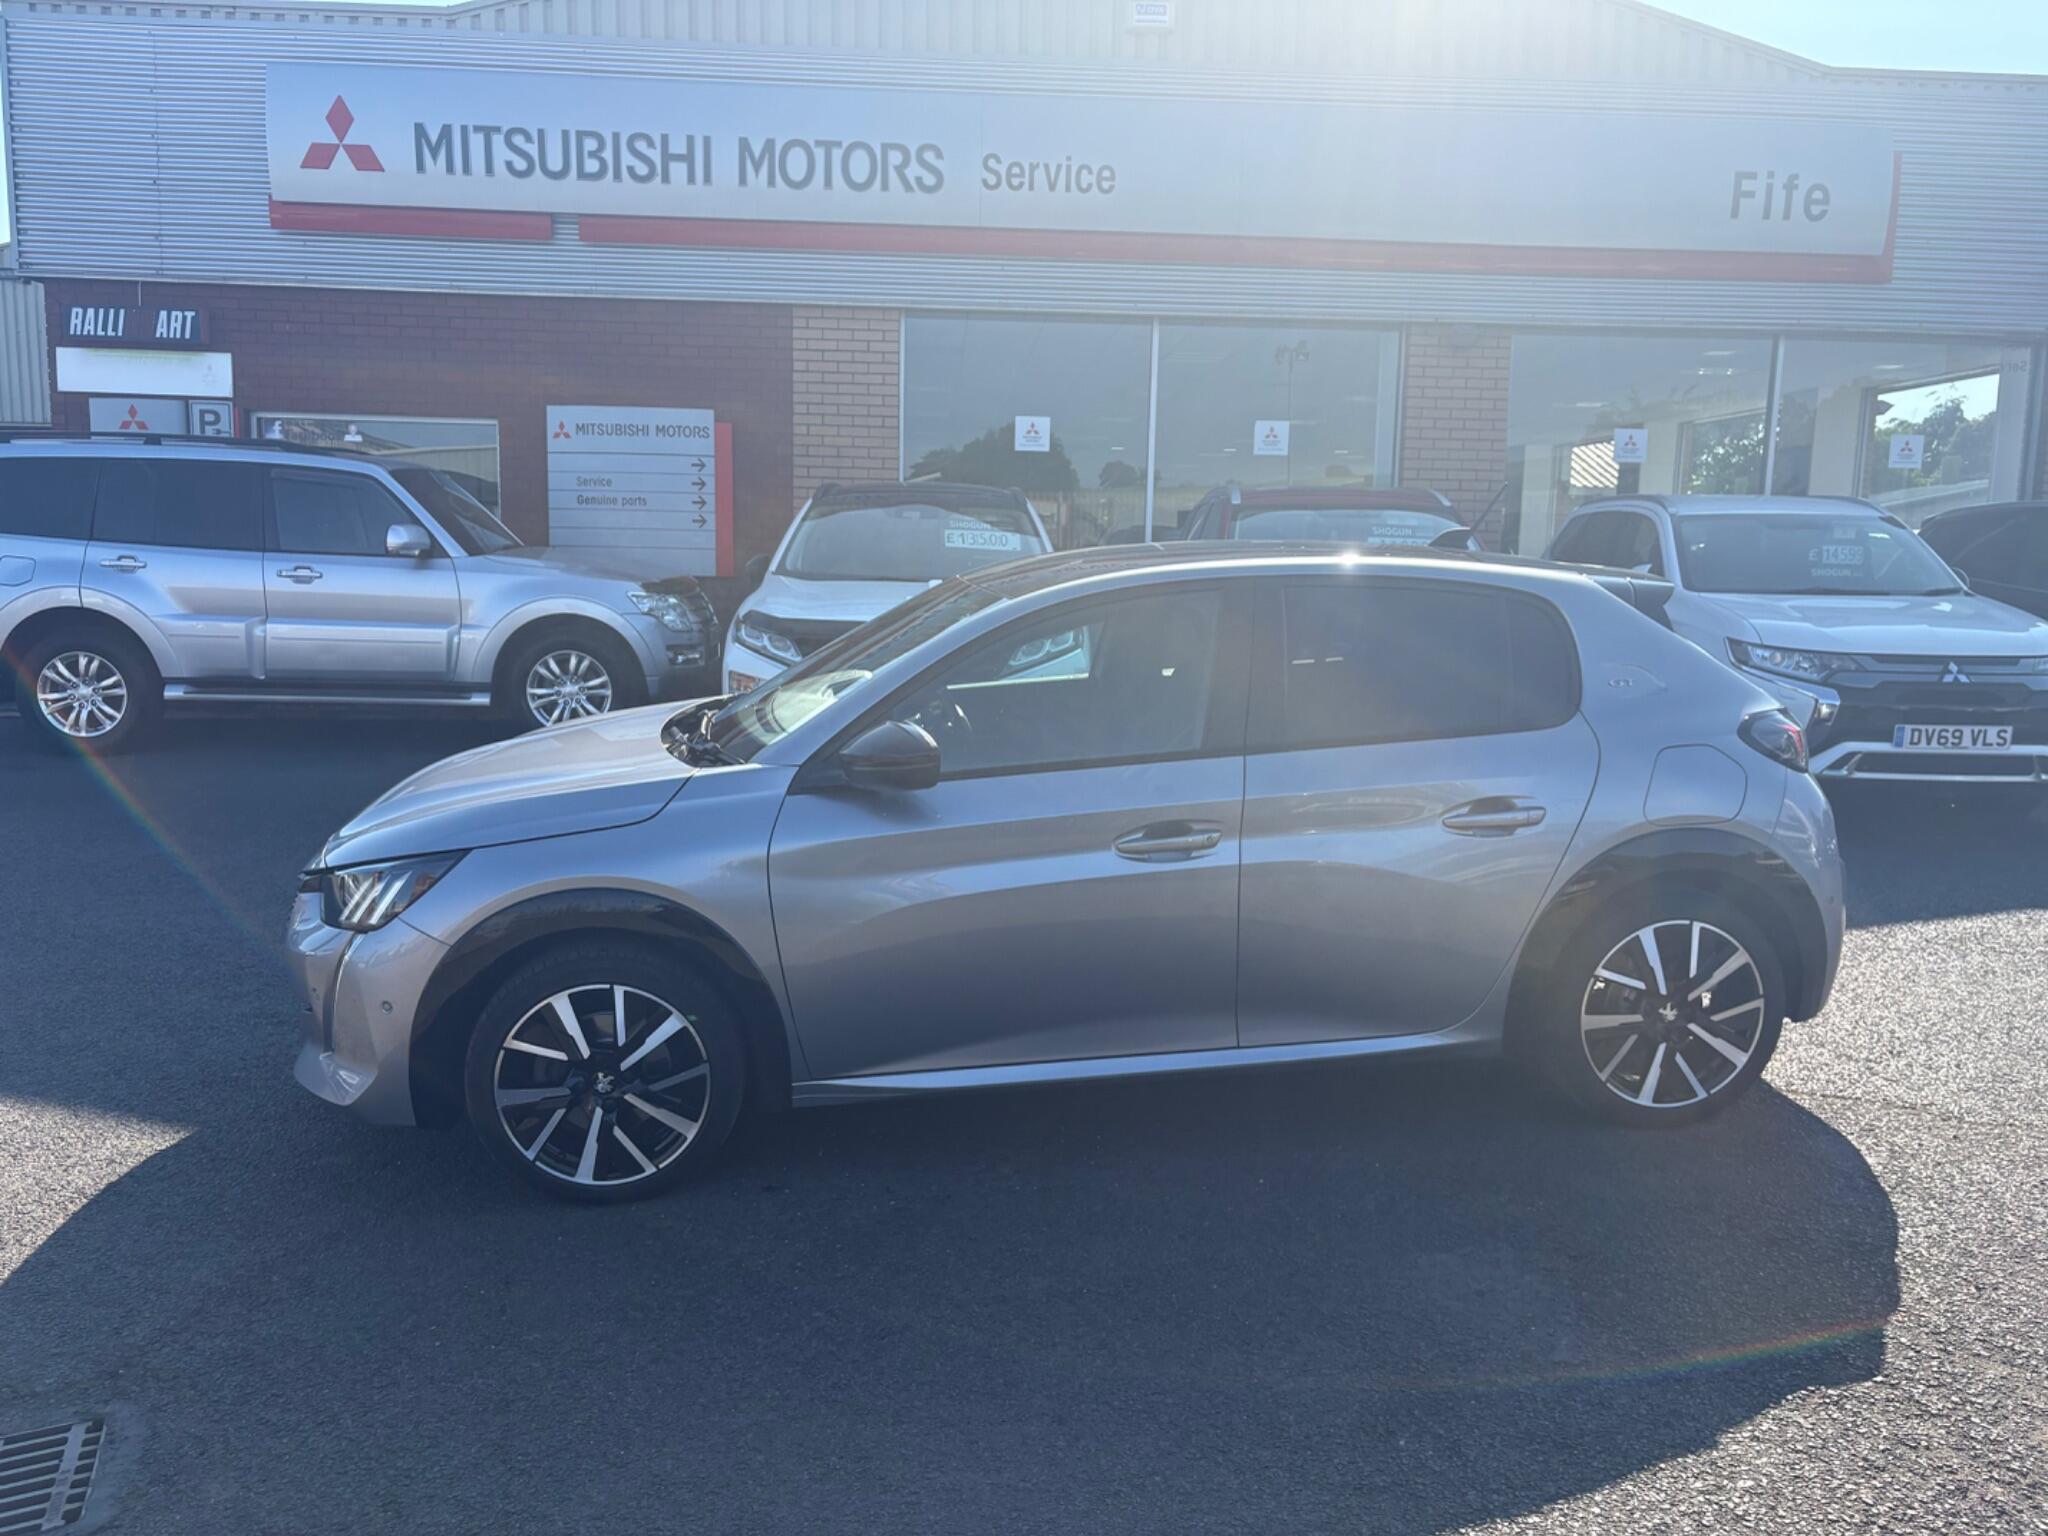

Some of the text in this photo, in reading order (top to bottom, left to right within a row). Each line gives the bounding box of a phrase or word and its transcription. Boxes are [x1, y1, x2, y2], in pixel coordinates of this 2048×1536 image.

[413, 122, 946, 195] MITSUBISHI MOTORS
[981, 152, 1117, 195] Service
[1729, 170, 1831, 223] Fife
[69, 307, 196, 340] RALLI ART
[199, 409, 222, 435] P
[575, 422, 711, 439] MITSUBISHI MOTORS
[575, 475, 613, 488] Service
[576, 494, 648, 507] Genuine parts
[1372, 526, 1413, 537] SHOGUN
[1908, 728, 2009, 748] DV69 VLS
